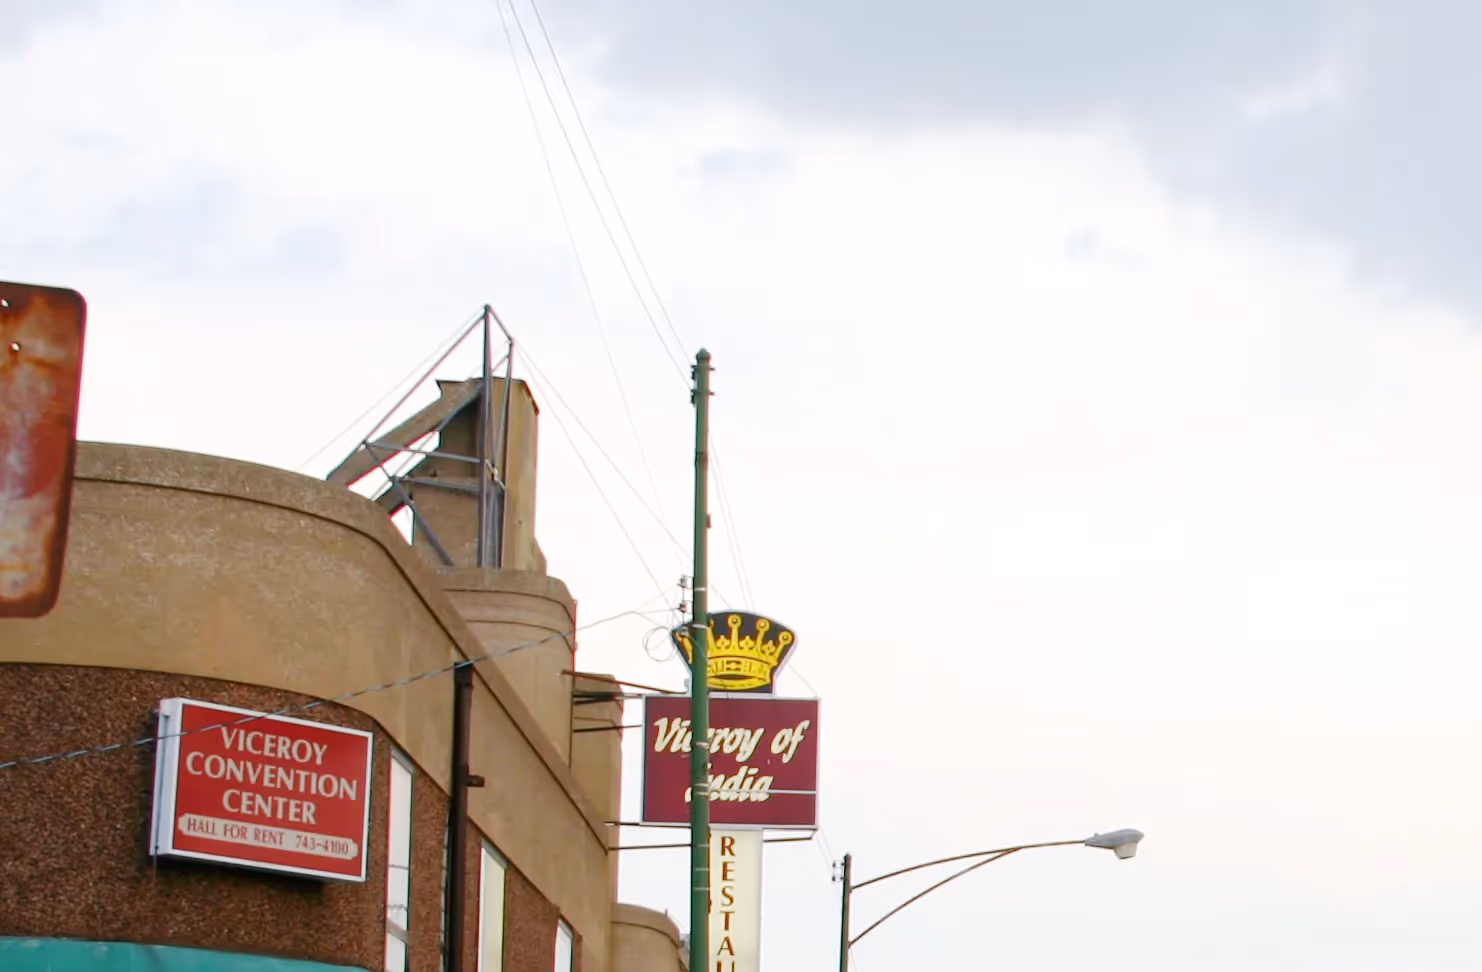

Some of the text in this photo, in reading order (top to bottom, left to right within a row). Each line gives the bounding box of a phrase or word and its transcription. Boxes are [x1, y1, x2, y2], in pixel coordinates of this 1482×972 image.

[220, 726, 328, 766] VICEROY
[654, 717, 810, 763] Vicroy of
[185, 751, 358, 800] CONVENTION
[222, 789, 317, 825] CENTER
[187, 817, 217, 836] HALL
[224, 823, 248, 840] FOR
[254, 827, 285, 846] RENT
